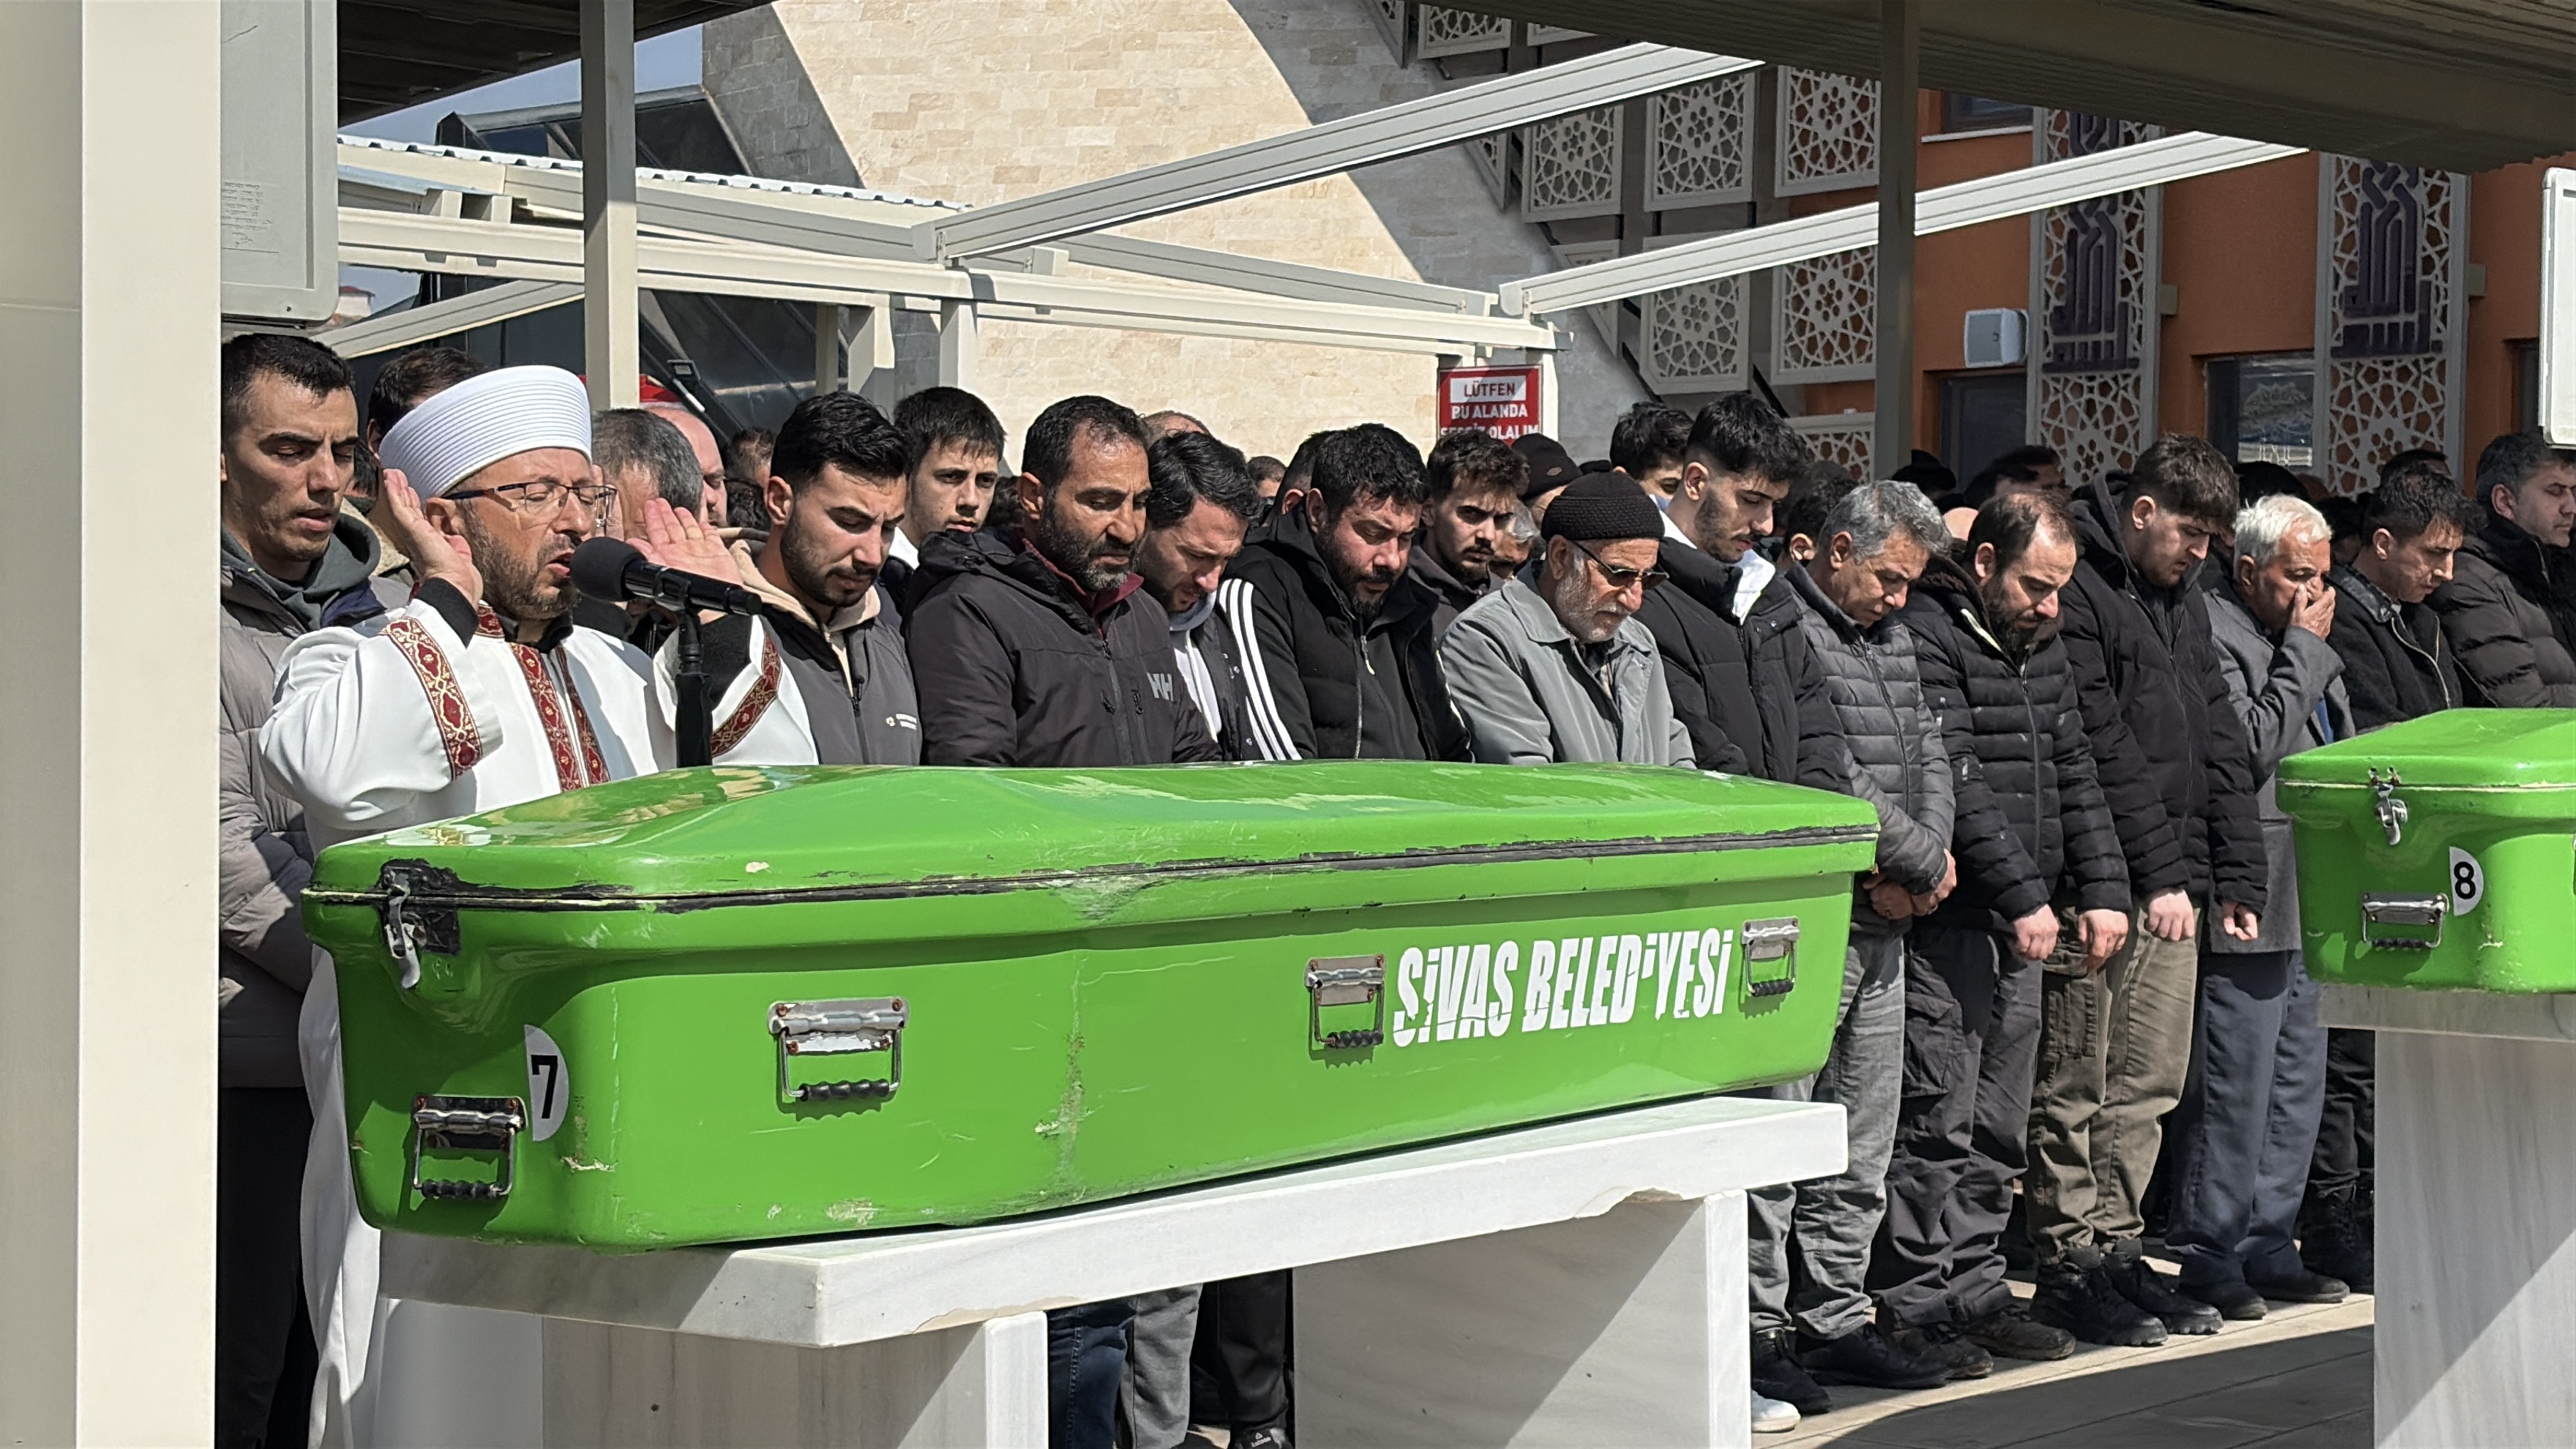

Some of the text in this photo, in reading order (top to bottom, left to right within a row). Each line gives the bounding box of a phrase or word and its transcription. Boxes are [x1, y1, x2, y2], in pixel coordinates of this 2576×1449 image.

[1464, 380, 1516, 397] LÜTFEN
[1451, 403, 1528, 420] BU ALANDA
[1146, 672, 1174, 702] HH
[2453, 861, 2476, 900] 8
[531, 1054, 558, 1120] 7
